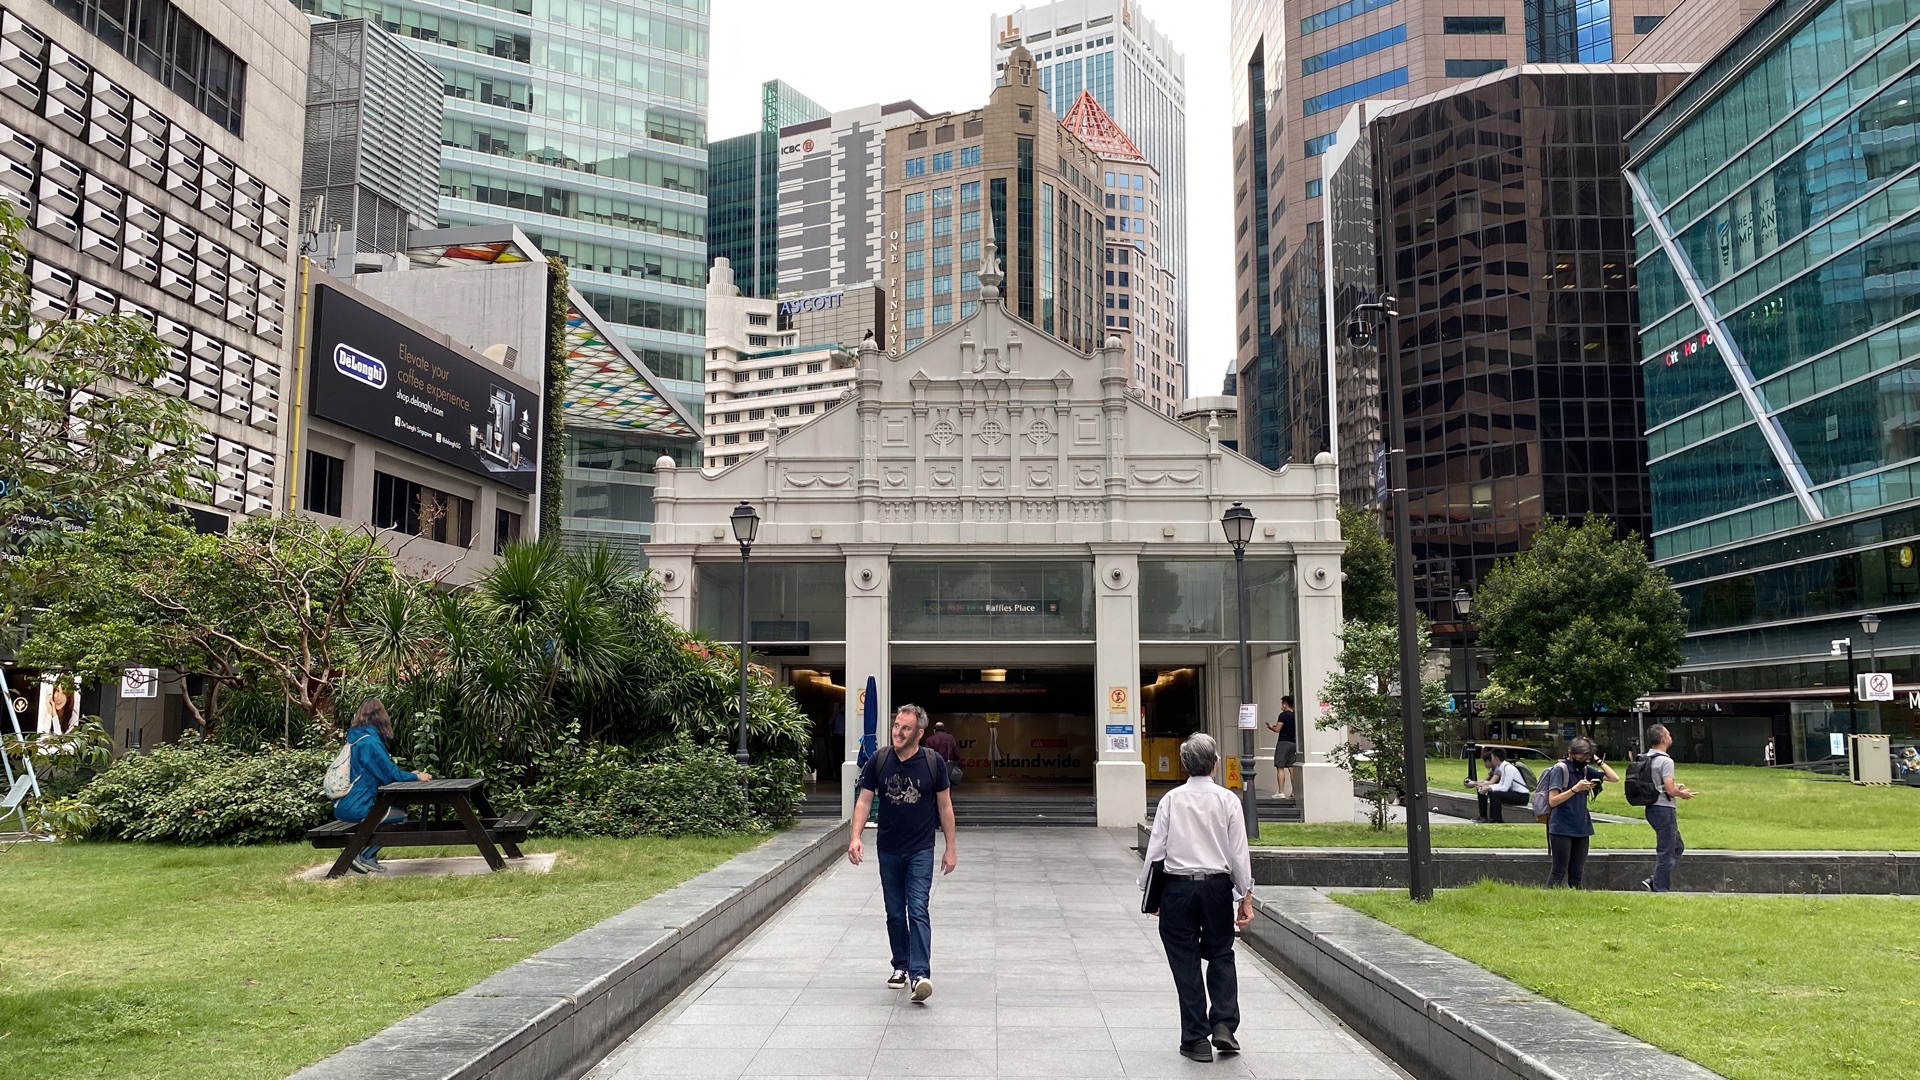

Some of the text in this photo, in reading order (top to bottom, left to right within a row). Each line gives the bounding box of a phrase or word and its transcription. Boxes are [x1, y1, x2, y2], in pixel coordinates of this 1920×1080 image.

[781, 143, 801, 155] ICBC
[890, 230, 899, 264] ONE
[780, 292, 844, 316] ASCOTT
[399, 342, 449, 380] Elevate your
[396, 388, 444, 417] shop.delonghi.com
[397, 367, 472, 412] coffee experience.
[985, 604, 1013, 613] Raffles
[1014, 604, 1036, 613] Place
